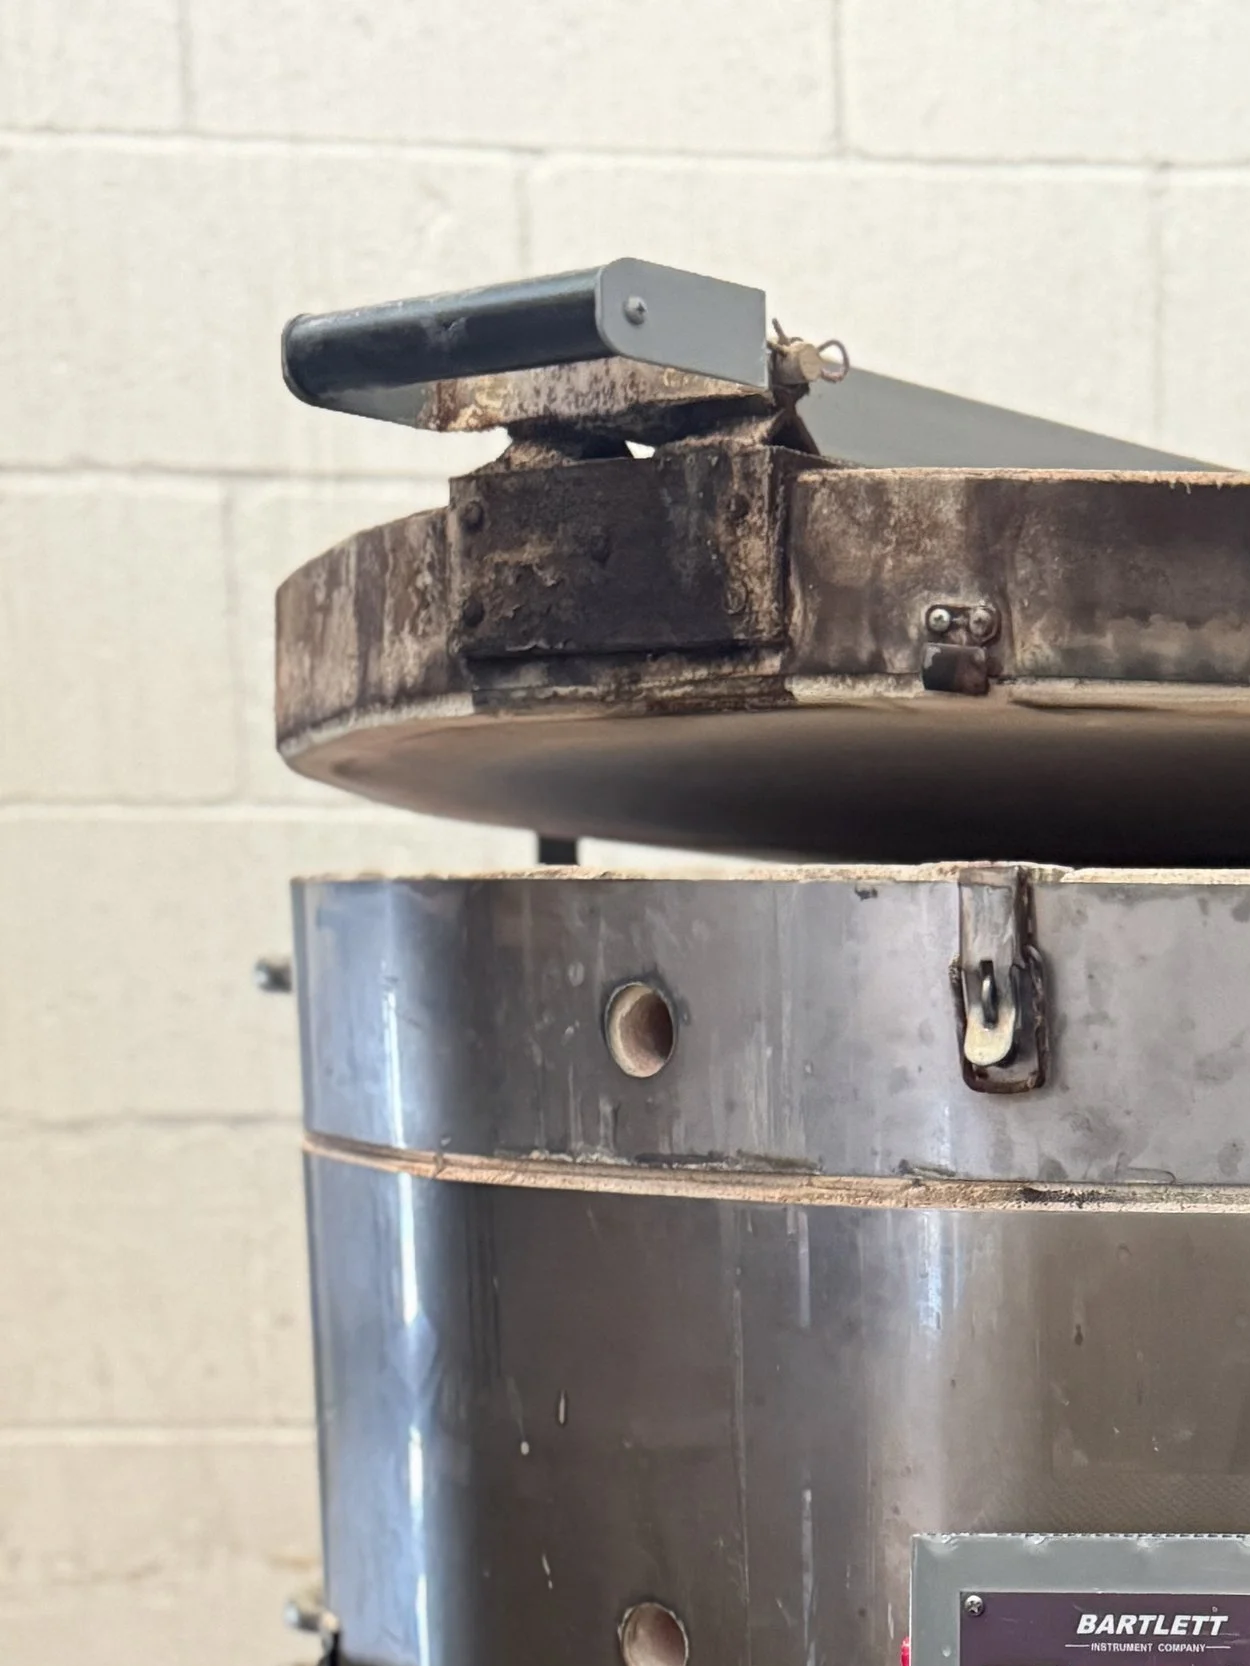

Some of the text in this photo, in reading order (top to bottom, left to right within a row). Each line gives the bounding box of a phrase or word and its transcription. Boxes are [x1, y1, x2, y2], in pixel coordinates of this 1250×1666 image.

[1076, 1614, 1228, 1636] BARTLETT
[1091, 1643, 1206, 1652] INSTRUMENT COMPANY
